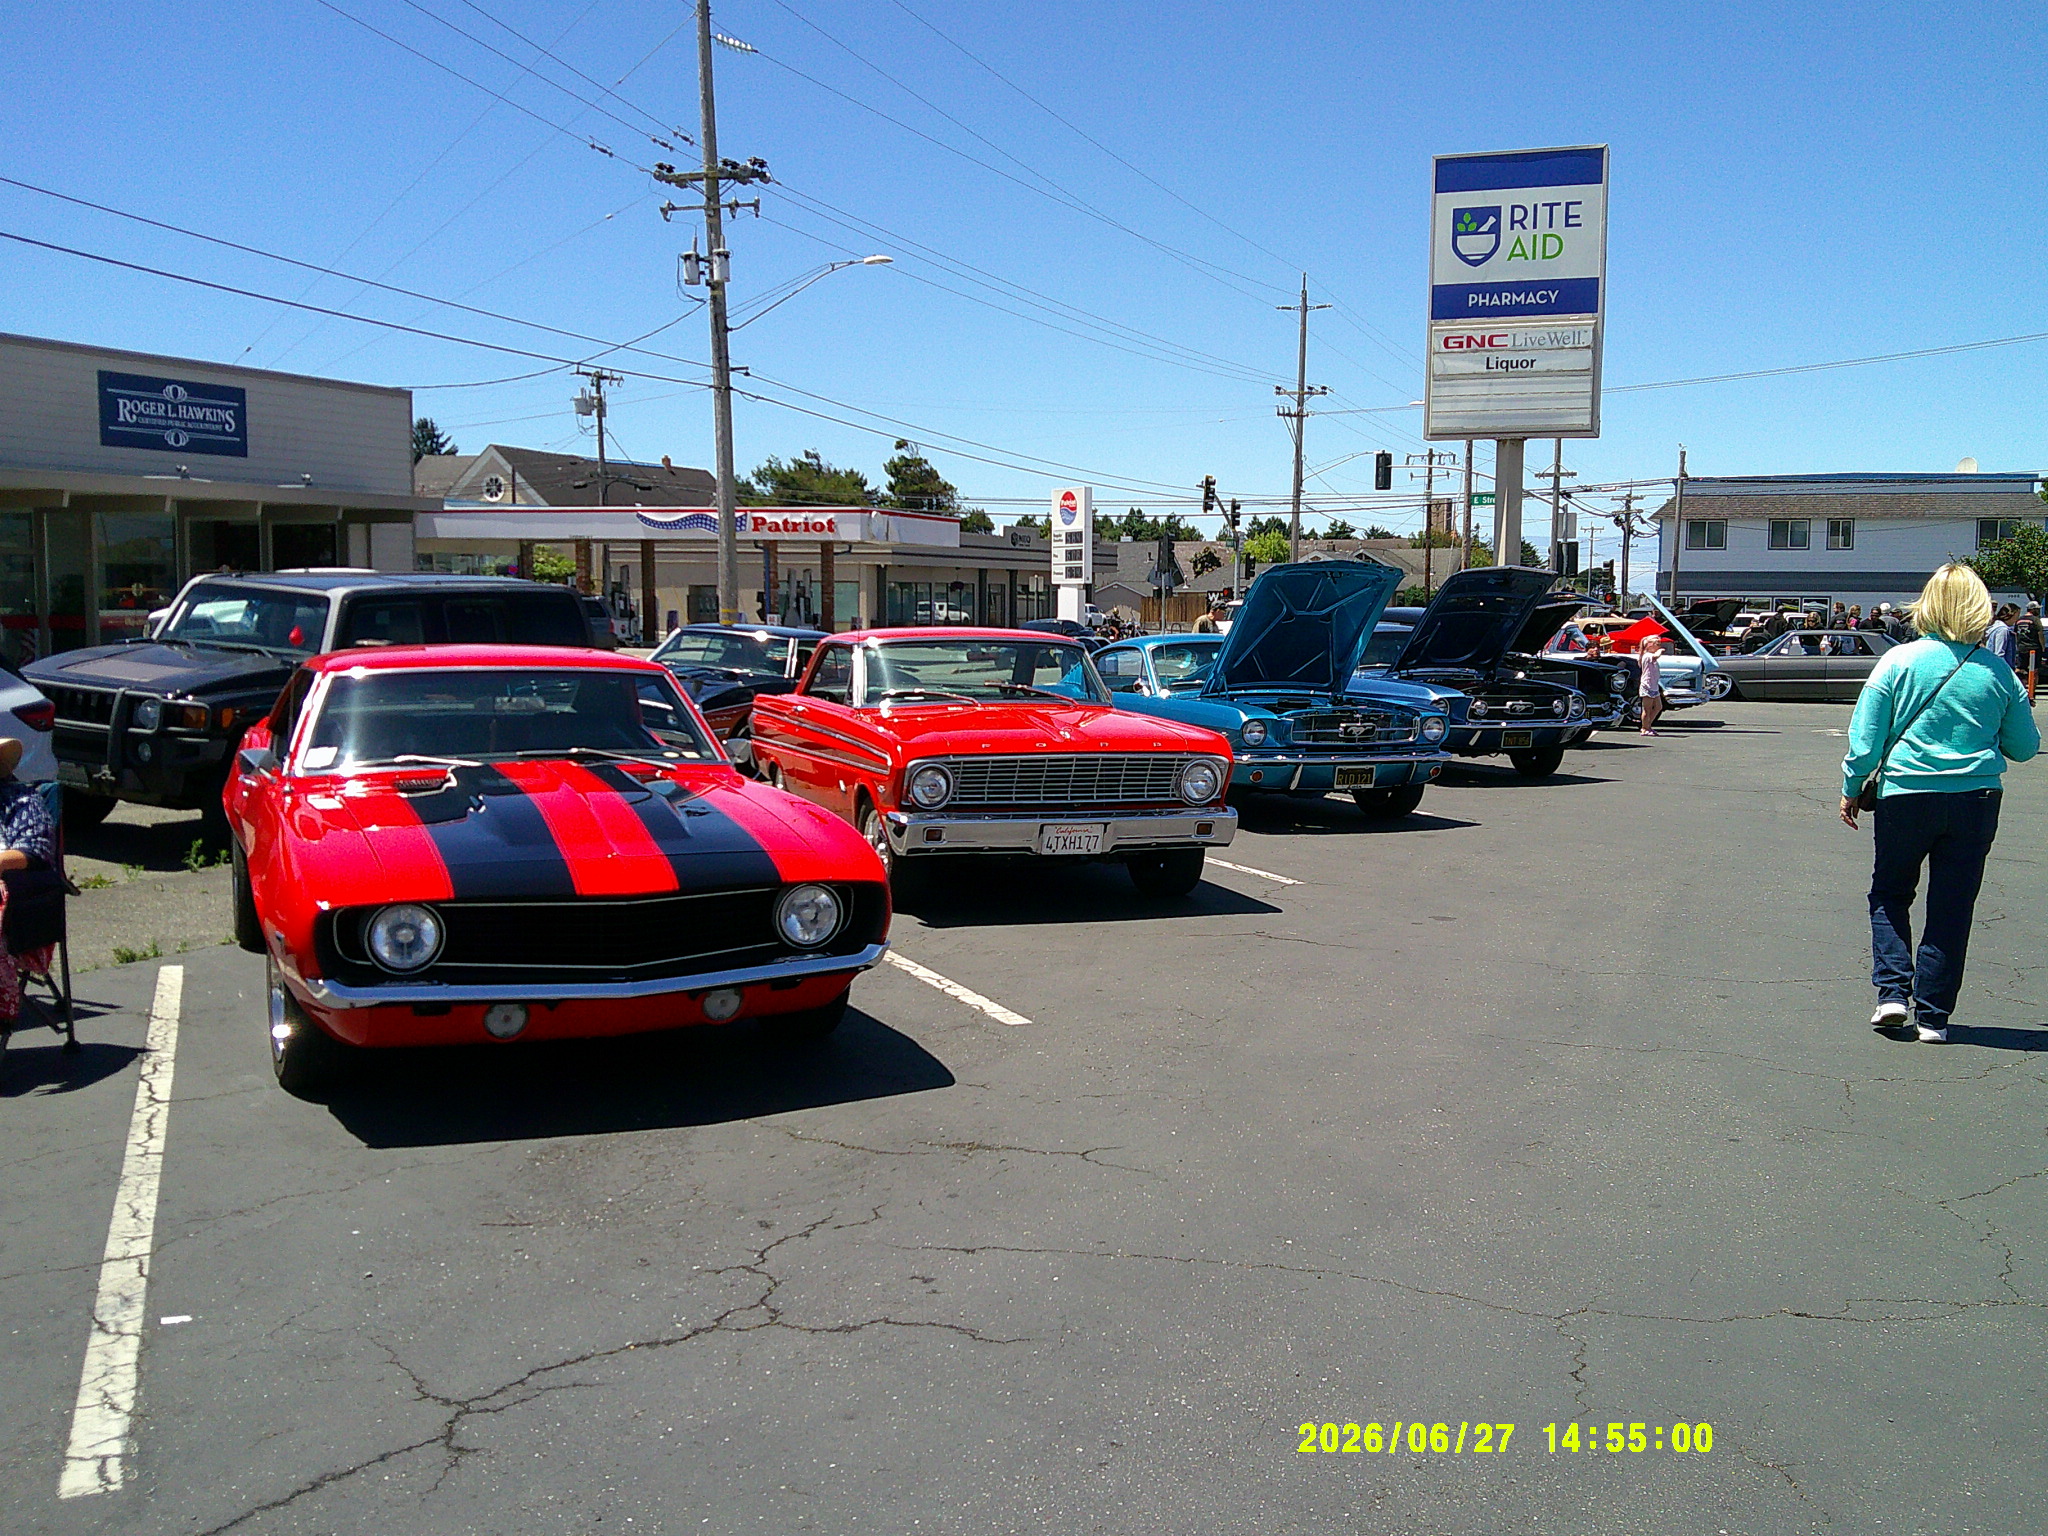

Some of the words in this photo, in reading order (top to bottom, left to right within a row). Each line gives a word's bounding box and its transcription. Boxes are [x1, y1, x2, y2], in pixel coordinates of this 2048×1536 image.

[1509, 200, 1583, 231] RITE
[1506, 233, 1564, 262] AID
[1467, 290, 1560, 308] PHARMACY
[1443, 334, 1509, 350] GNC
[1485, 356, 1537, 372] Liquor
[117, 398, 166, 423] ROGER
[168, 404, 177, 418] L.
[178, 404, 235, 432] HAWKINS
[1474, 496, 1480, 504] E
[752, 514, 835, 533] Patriot
[1045, 835, 1100, 850] 4TXH177
